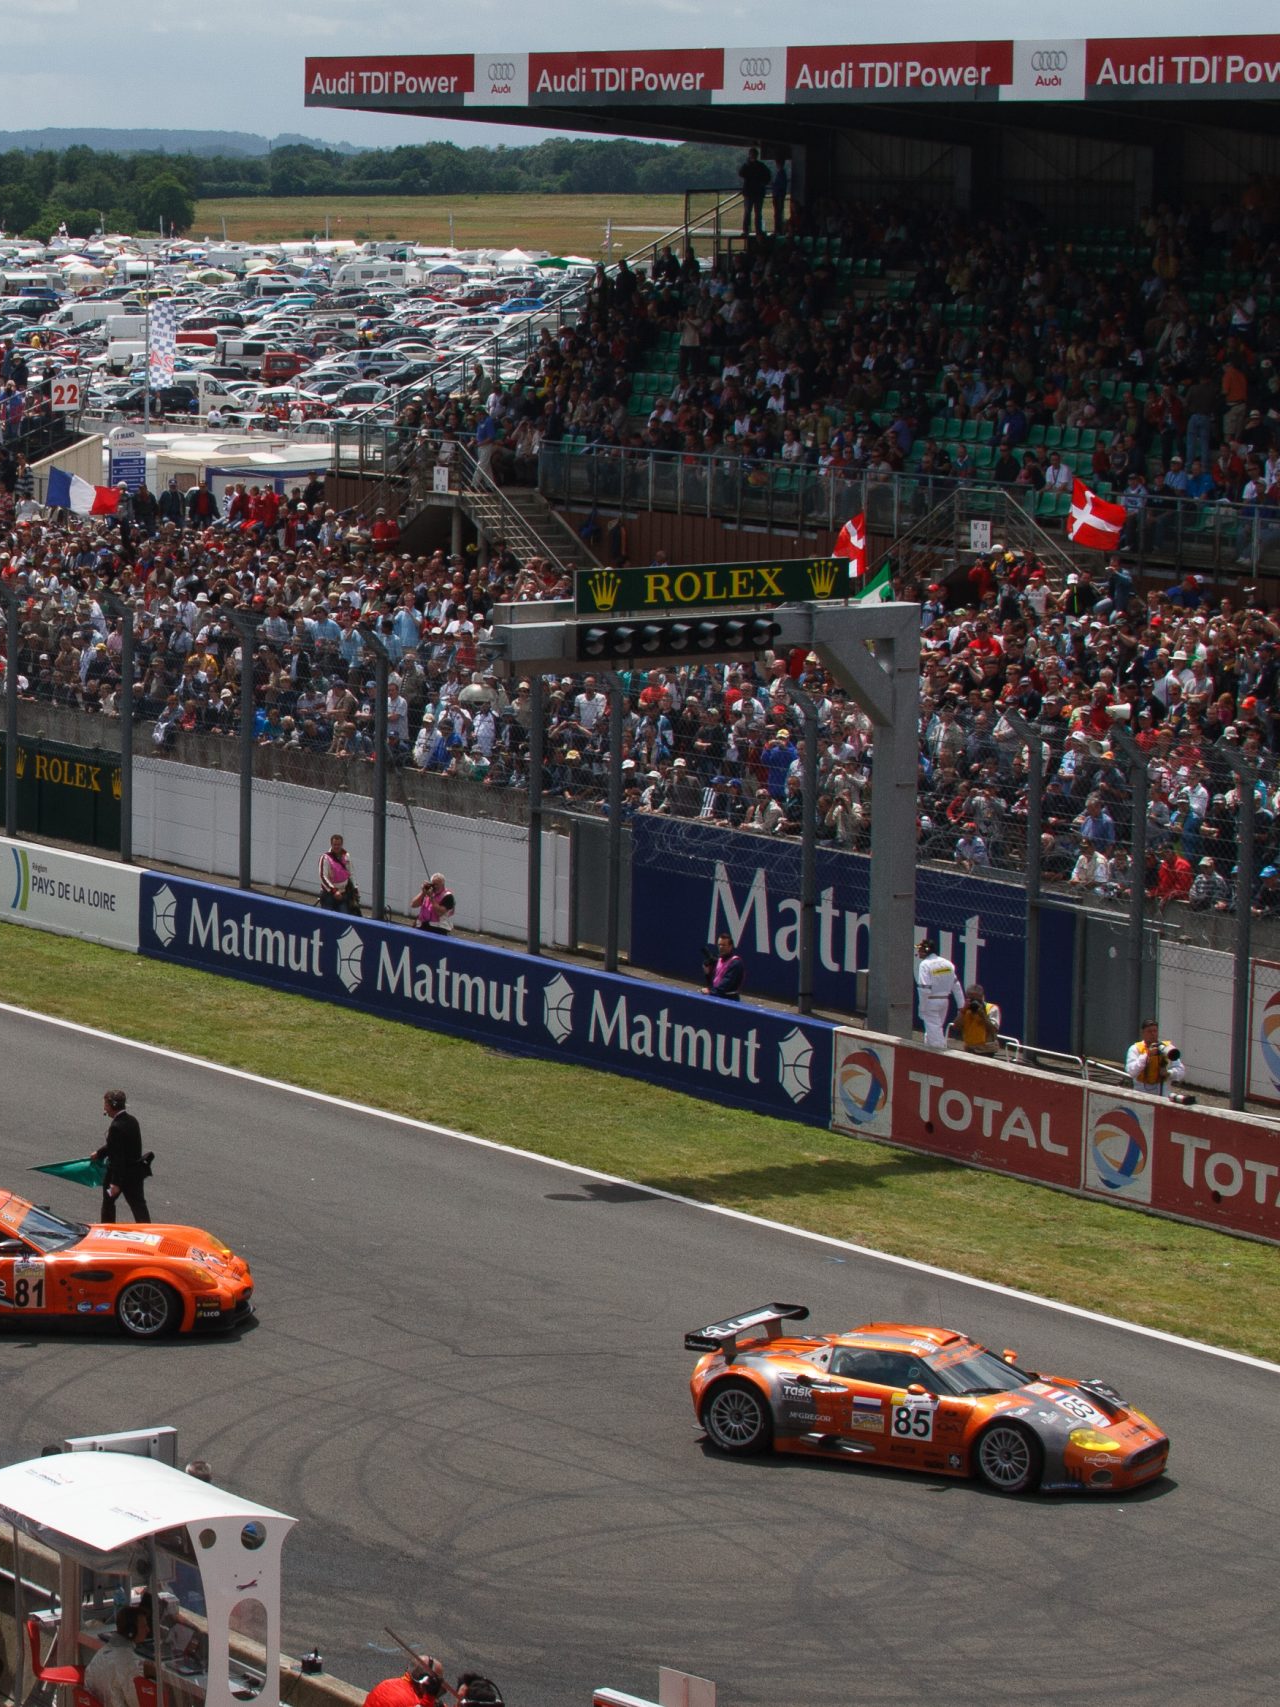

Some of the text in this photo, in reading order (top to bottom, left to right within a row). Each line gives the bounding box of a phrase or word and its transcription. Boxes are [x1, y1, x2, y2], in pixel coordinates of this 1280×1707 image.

[311, 72, 355, 95] Audi
[394, 73, 459, 93] Power
[536, 67, 586, 93] Audi
[632, 67, 705, 91] Power
[743, 80, 766, 91] Audi
[795, 62, 853, 89] Audi
[905, 61, 991, 87] Power
[1035, 75, 1061, 87] Audi
[1096, 56, 1163, 85] Audi
[491, 83, 512, 95] Audi
[53, 384, 79, 405] 22
[643, 568, 785, 603] ROLEX
[34, 755, 102, 792] ROLEX
[31, 875, 117, 912] PAYS DE LA LOIRE
[187, 897, 323, 977] Matmut
[376, 940, 528, 1027] Matmut
[588, 989, 761, 1084] Matmut
[908, 1070, 1069, 1157] TOTAL
[1170, 1130, 1280, 1208] TOT
[14, 1278, 45, 1308] 81
[894, 1406, 930, 1438] 85
[1061, 1397, 1095, 1419] 85
